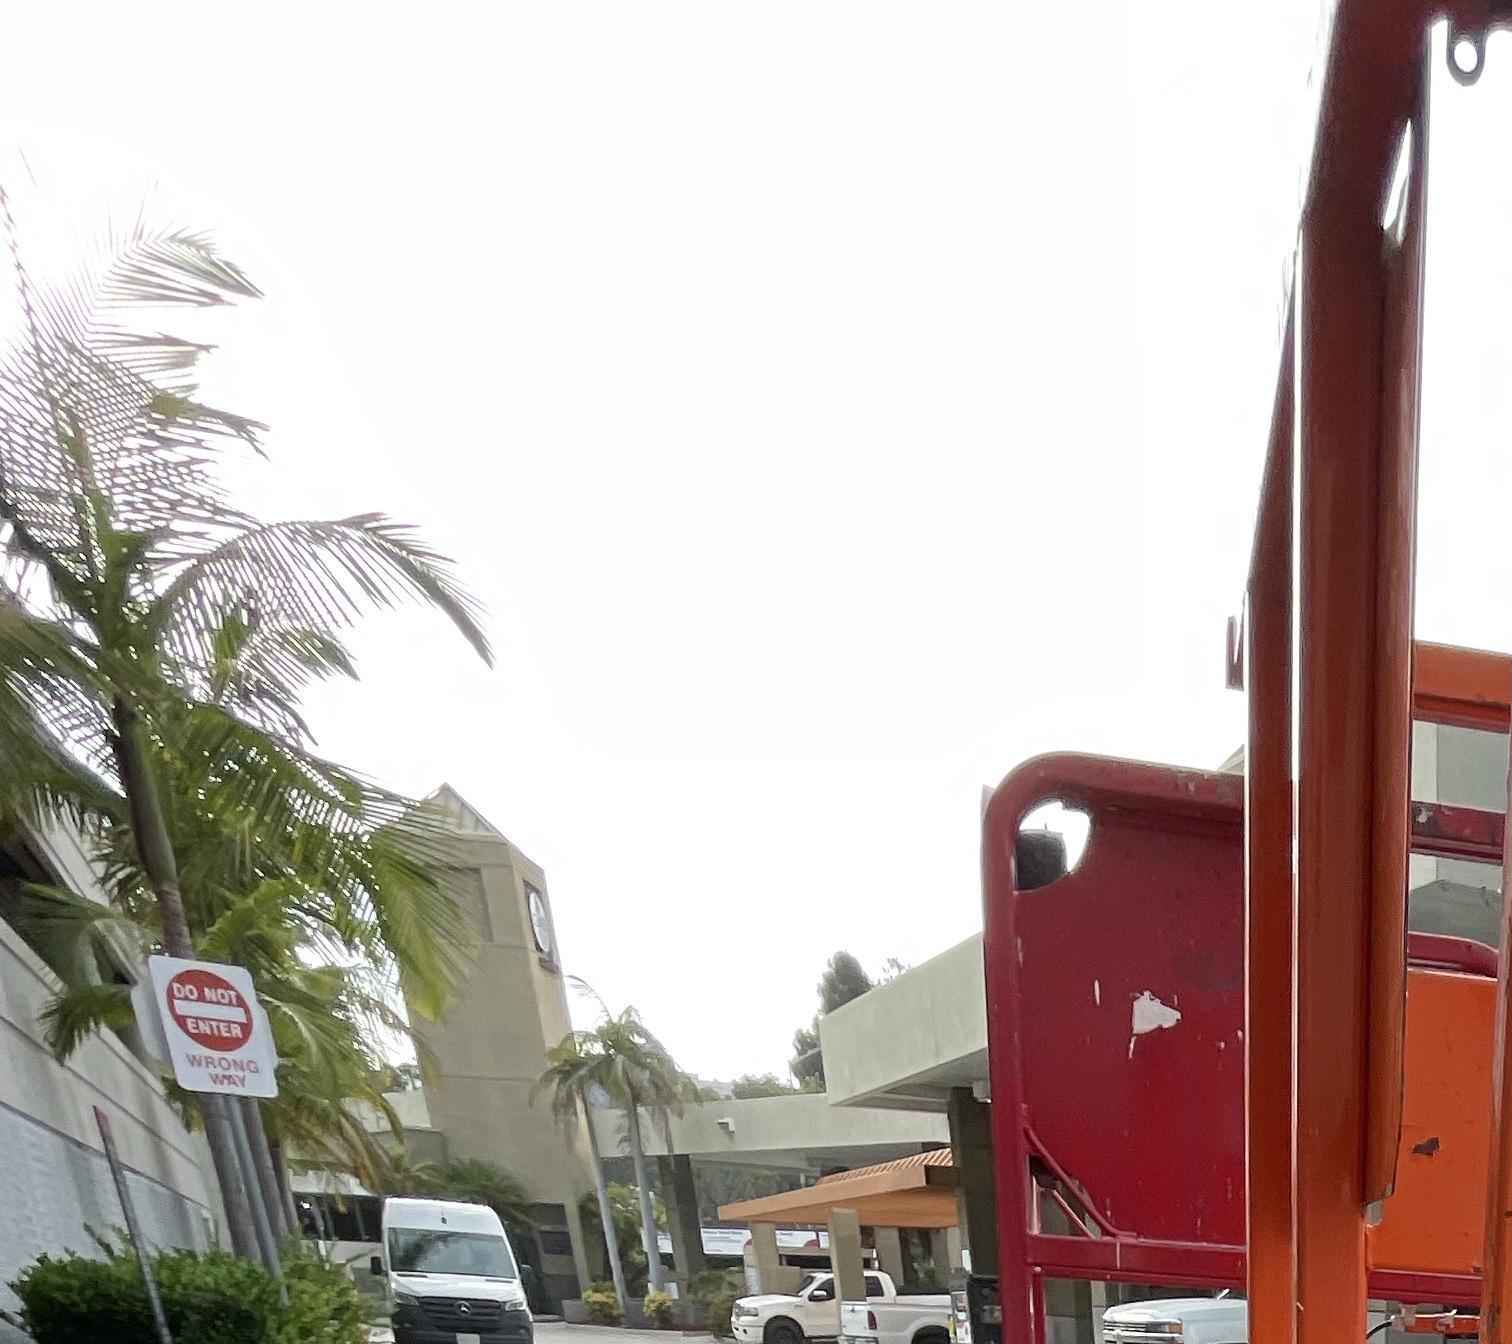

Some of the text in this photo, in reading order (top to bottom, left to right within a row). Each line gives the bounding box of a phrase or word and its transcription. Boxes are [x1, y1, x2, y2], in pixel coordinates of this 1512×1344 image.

[172, 982, 239, 1005] DO NOT
[187, 1018, 243, 1039] ENTER
[185, 1053, 260, 1074] WRONG
[209, 1072, 247, 1088] WAY
